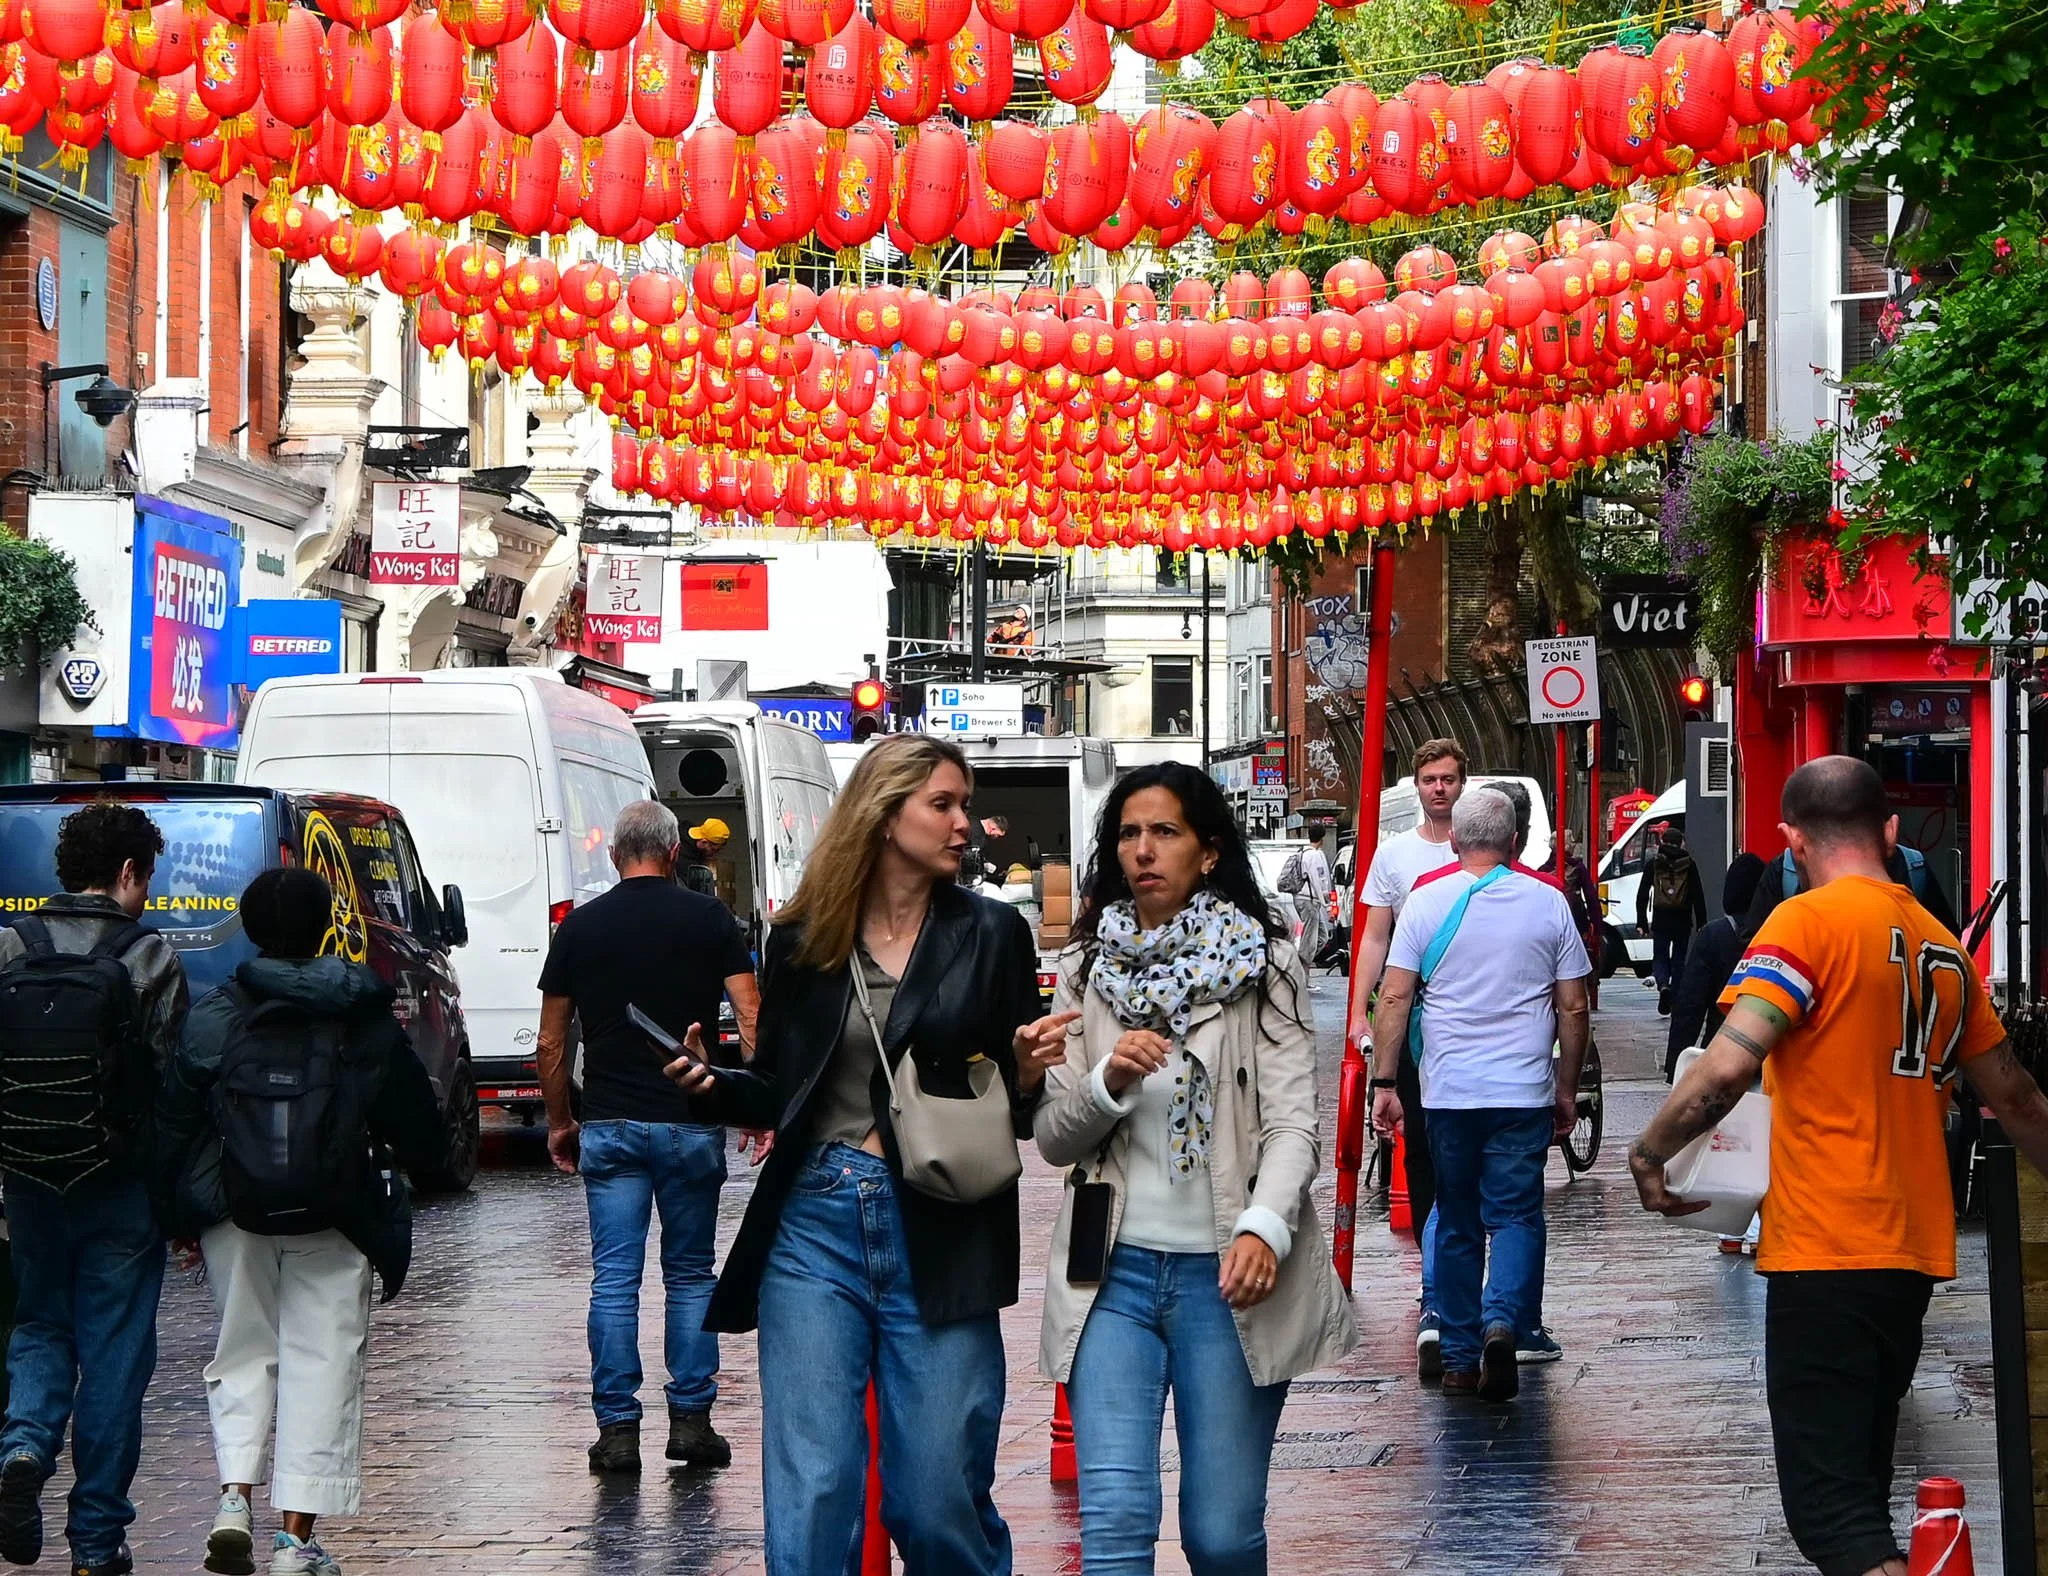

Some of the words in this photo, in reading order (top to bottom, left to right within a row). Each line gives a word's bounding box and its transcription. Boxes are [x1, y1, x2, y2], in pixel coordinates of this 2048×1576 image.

[1280, 302, 1308, 312] LNER
[397, 487, 436, 550] 旺記
[374, 557, 425, 580] Wong
[430, 557, 456, 577] Kei
[154, 554, 227, 632] BETFRED
[608, 558, 642, 613] 旺記
[1304, 596, 1351, 616] TOX
[1613, 594, 1688, 632] Viet
[588, 617, 632, 640] Wong
[637, 617, 659, 637] Kei
[252, 639, 332, 653] BETFRED
[1532, 640, 1589, 650] PEDESTRIAN
[1541, 650, 1582, 663] ZONE
[171, 634, 204, 714] 必发
[971, 718, 1003, 726] Brewer
[1007, 718, 1017, 726] St
[1556, 710, 1589, 719] vehicles
[1269, 788, 1287, 796] ATM
[144, 896, 237, 911] LEANING
[1888, 926, 1970, 1091] 10
